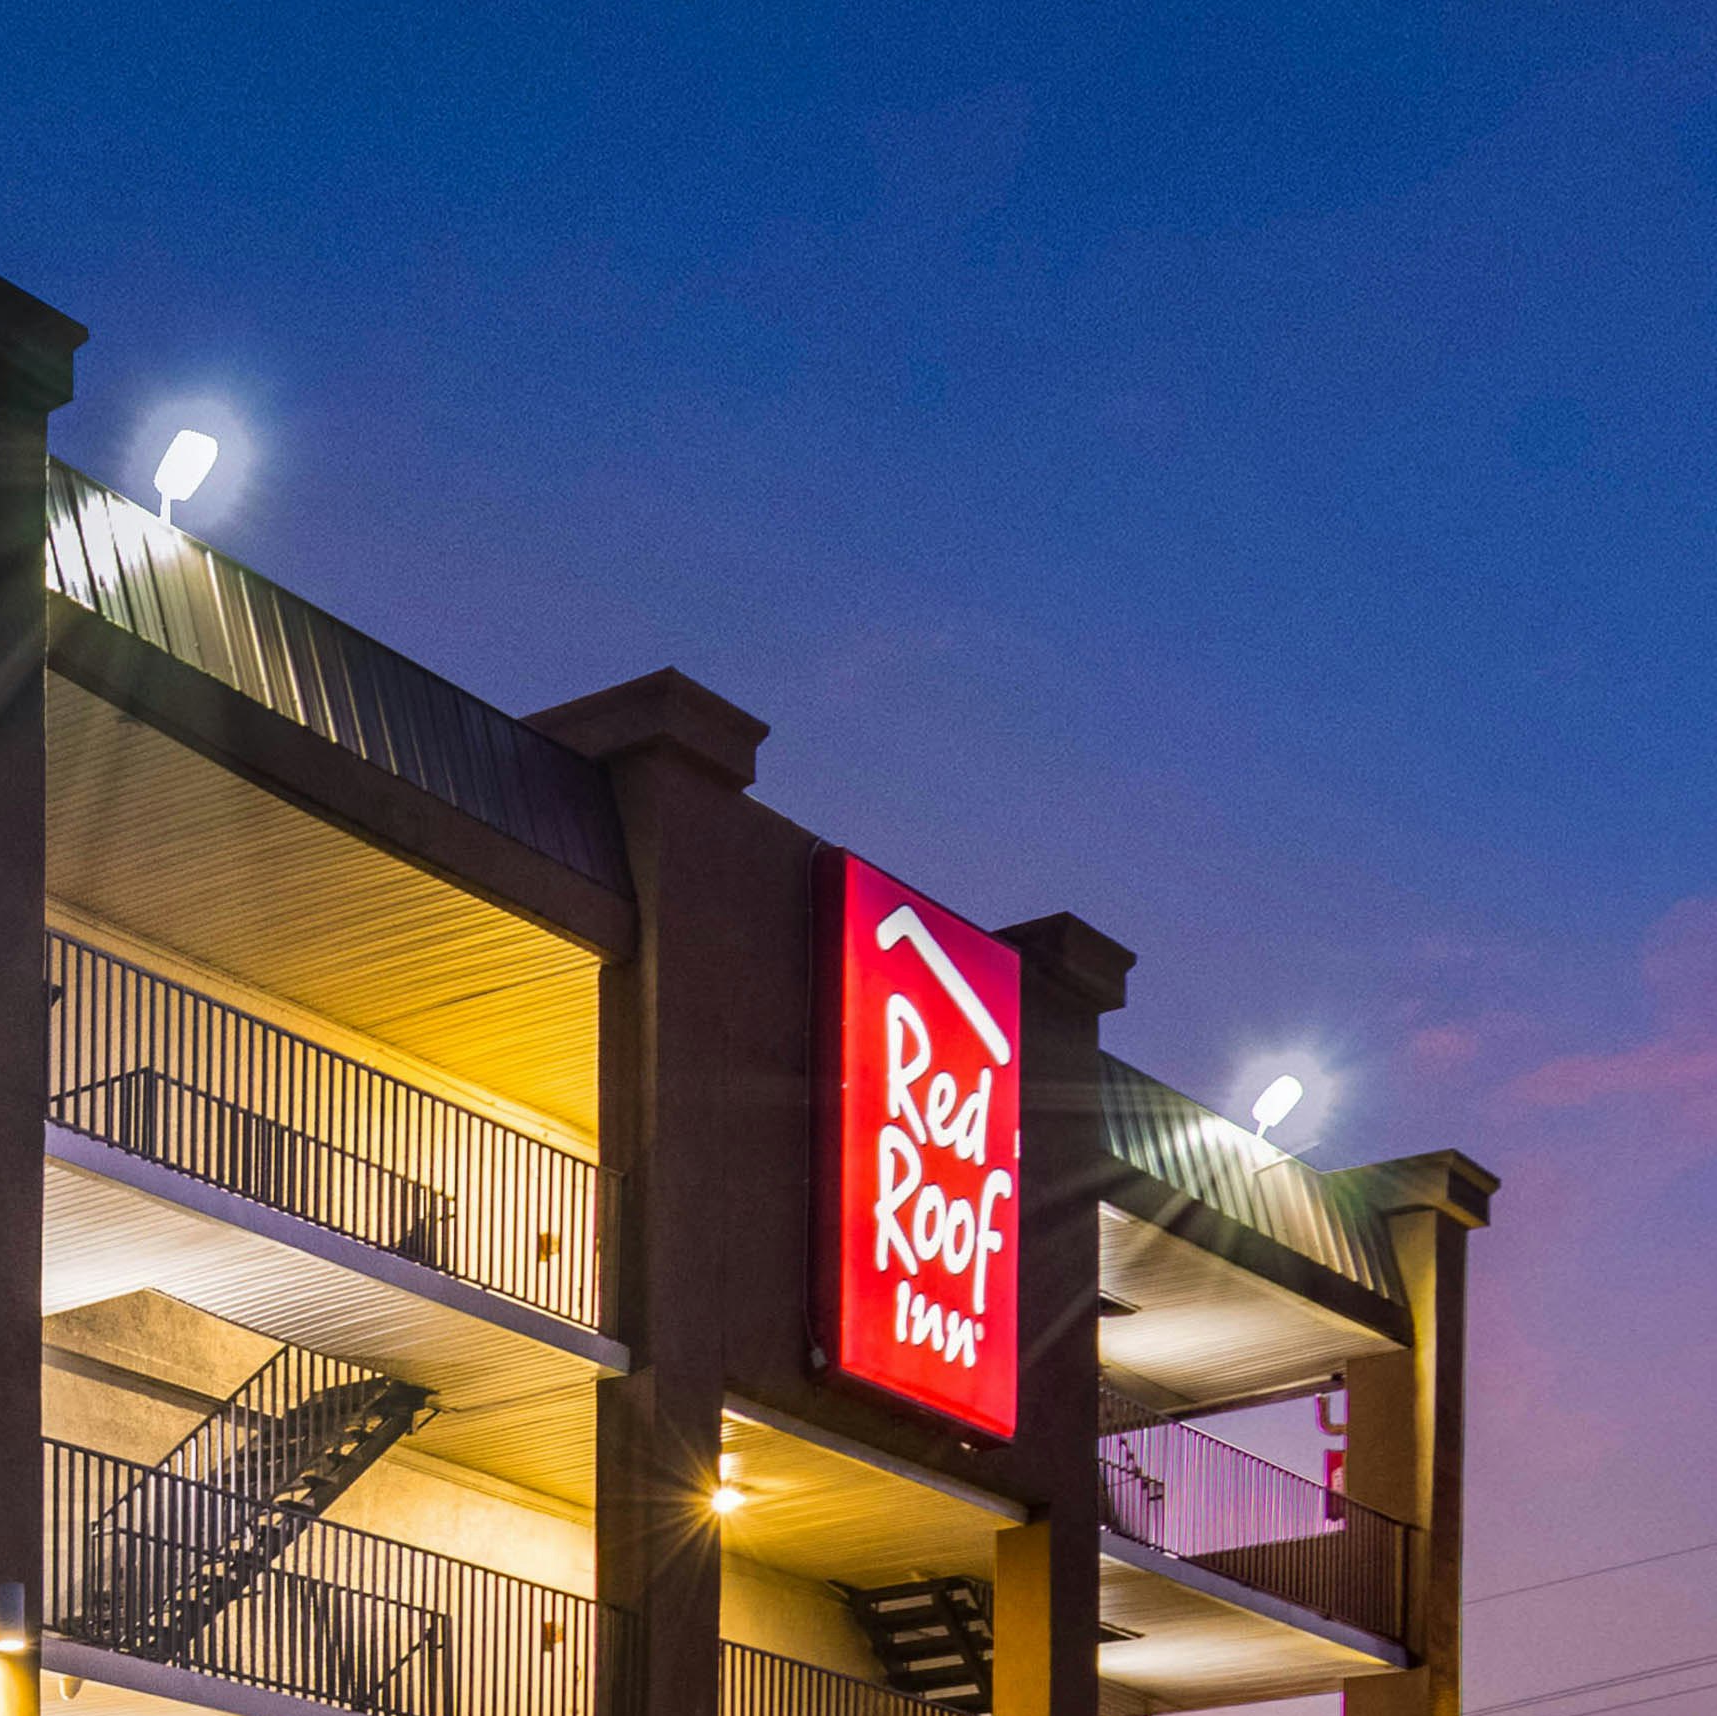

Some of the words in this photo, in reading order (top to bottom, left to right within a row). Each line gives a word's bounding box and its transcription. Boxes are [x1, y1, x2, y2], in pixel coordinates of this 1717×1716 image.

[886, 993, 993, 1166] Red
[875, 1123, 1012, 1315] Roof
[895, 1280, 977, 1368] Inn
